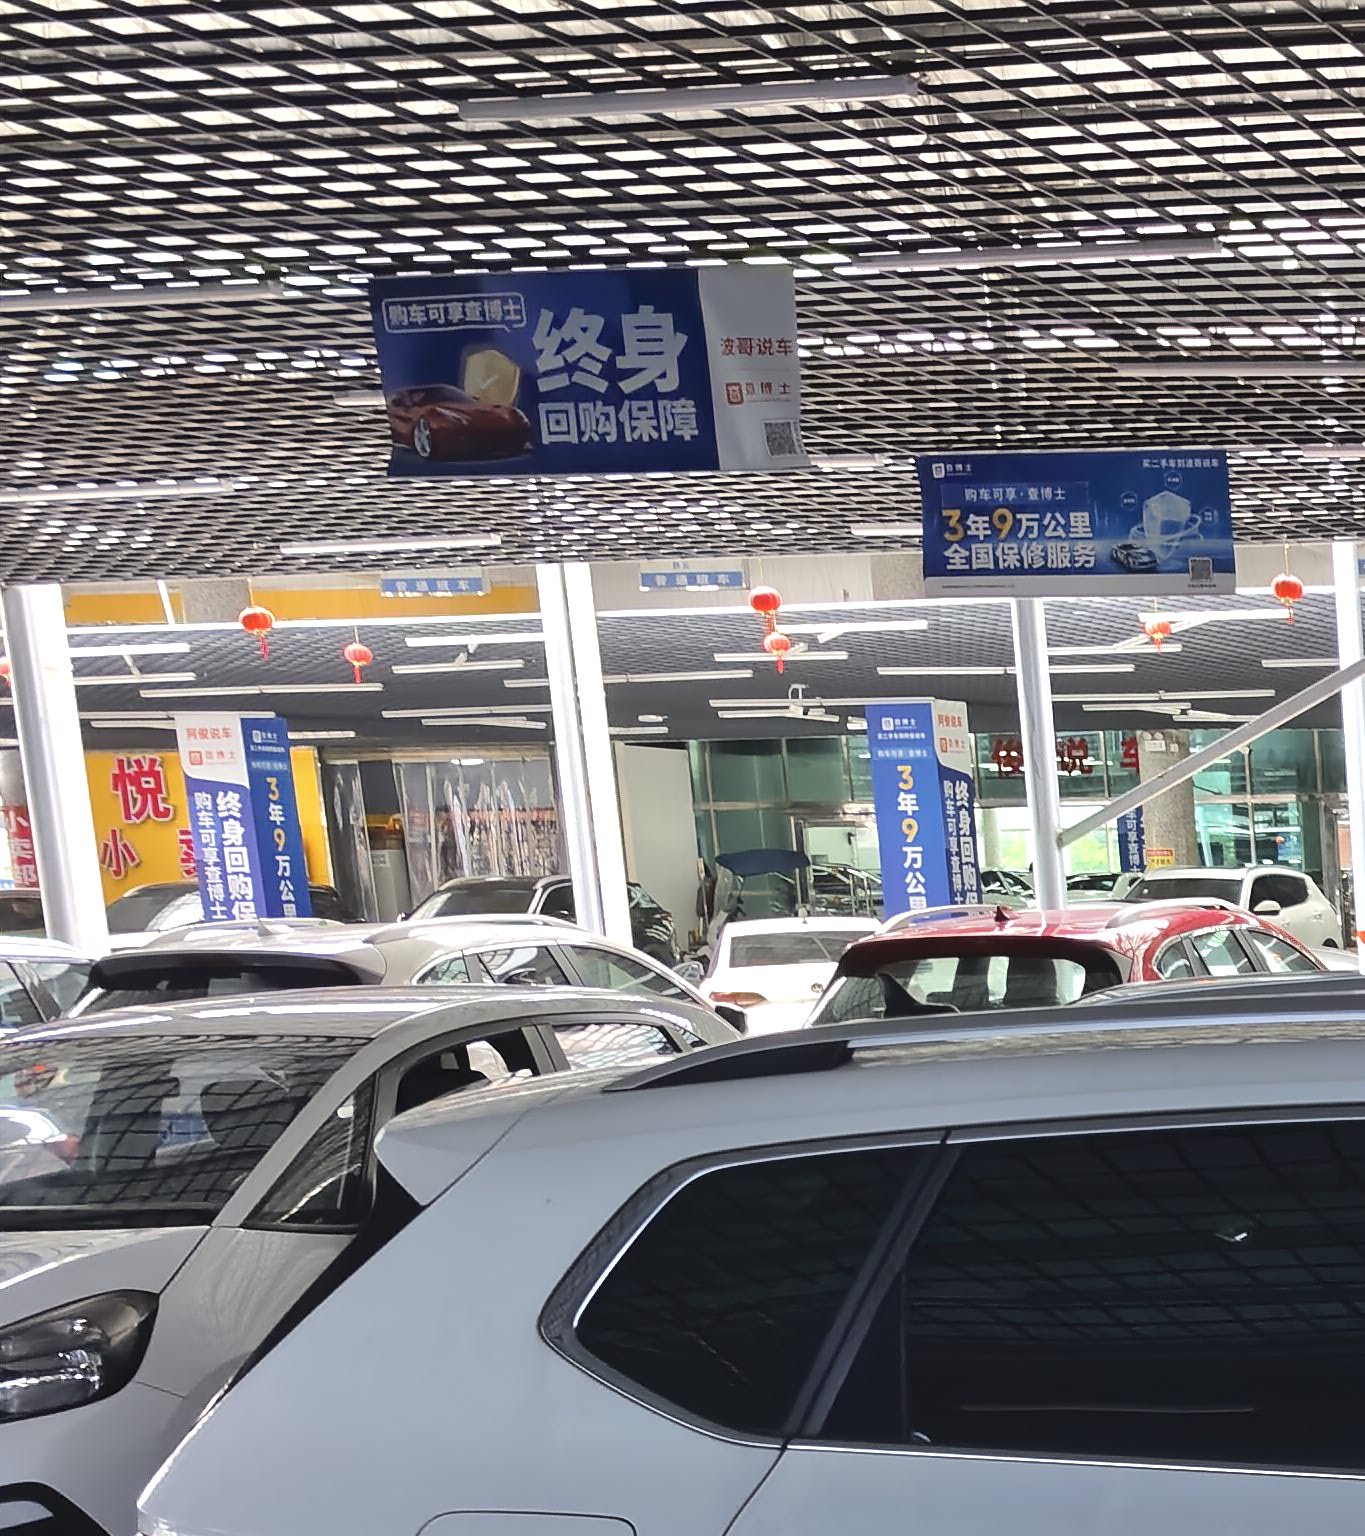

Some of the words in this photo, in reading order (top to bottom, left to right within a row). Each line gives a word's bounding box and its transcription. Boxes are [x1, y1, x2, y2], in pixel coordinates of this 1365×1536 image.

[388, 299, 521, 325] 购车可享查博士
[532, 305, 688, 394] 终身
[720, 337, 793, 356] 波哥说车
[538, 398, 699, 444] 回购保障
[942, 508, 1093, 541] 3年9万公里
[943, 542, 1097, 570] 全国保修服务
[186, 727, 232, 740] 阿俊说车
[111, 755, 175, 823] 悦
[193, 791, 228, 920] 购车可享查博士
[266, 777, 297, 917] 3年9万公里
[896, 765, 928, 910] 3年9万公里
